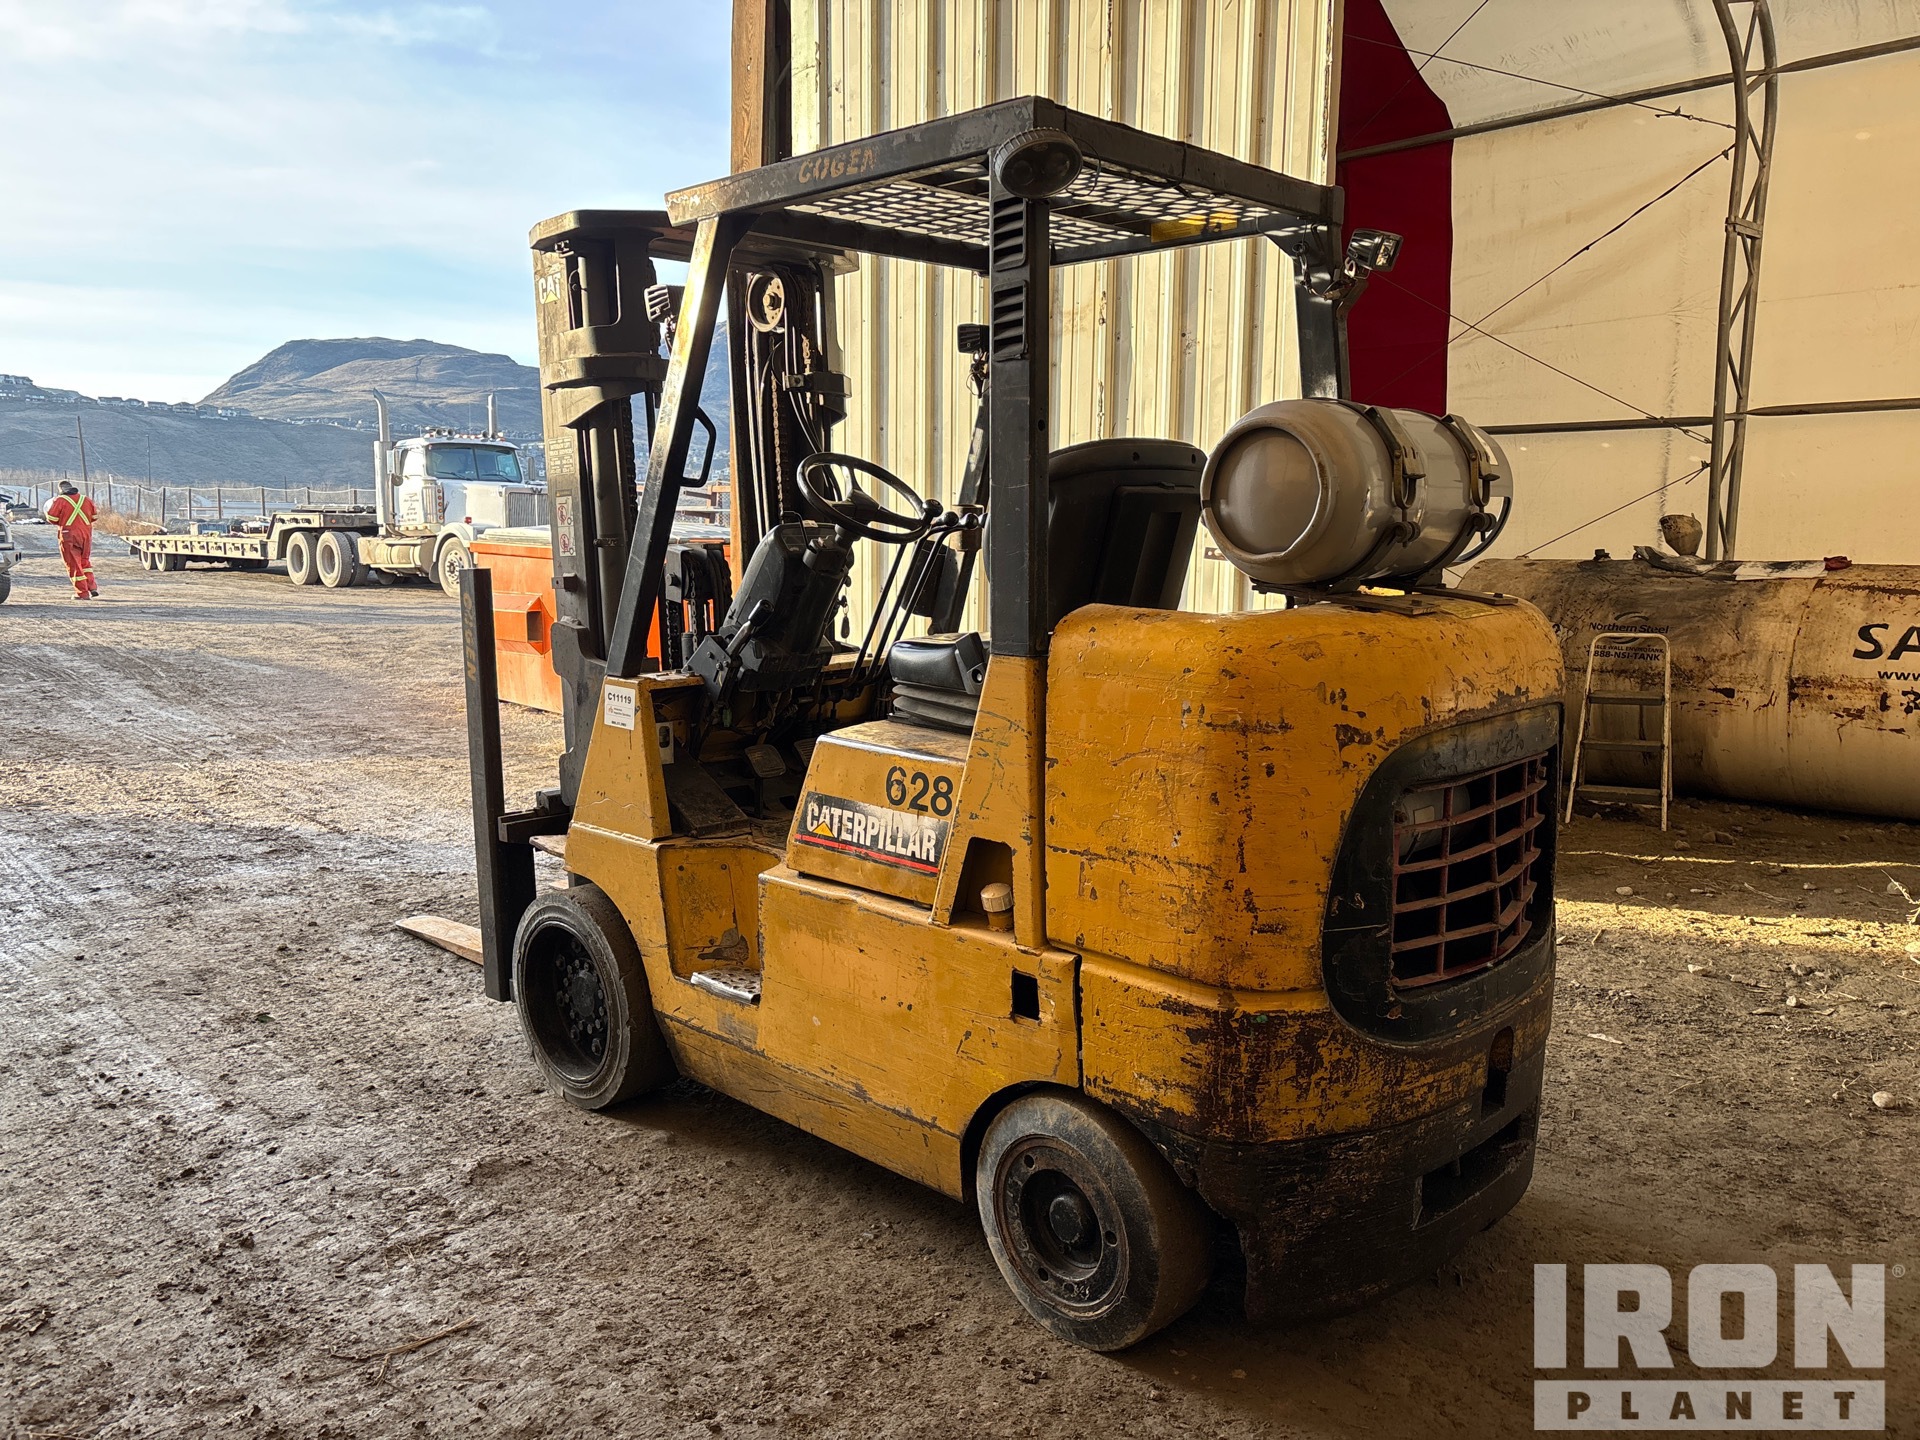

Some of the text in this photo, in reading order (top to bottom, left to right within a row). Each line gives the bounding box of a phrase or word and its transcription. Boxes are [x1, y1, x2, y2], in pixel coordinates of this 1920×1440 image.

[538, 272, 561, 305] CAT
[1589, 622, 1670, 634] Northern Steel
[1586, 650, 1661, 661] 1888-NSI-TANK
[607, 692, 632, 705] C11119
[886, 765, 954, 817] 628
[806, 801, 938, 863] CATERPILLAR
